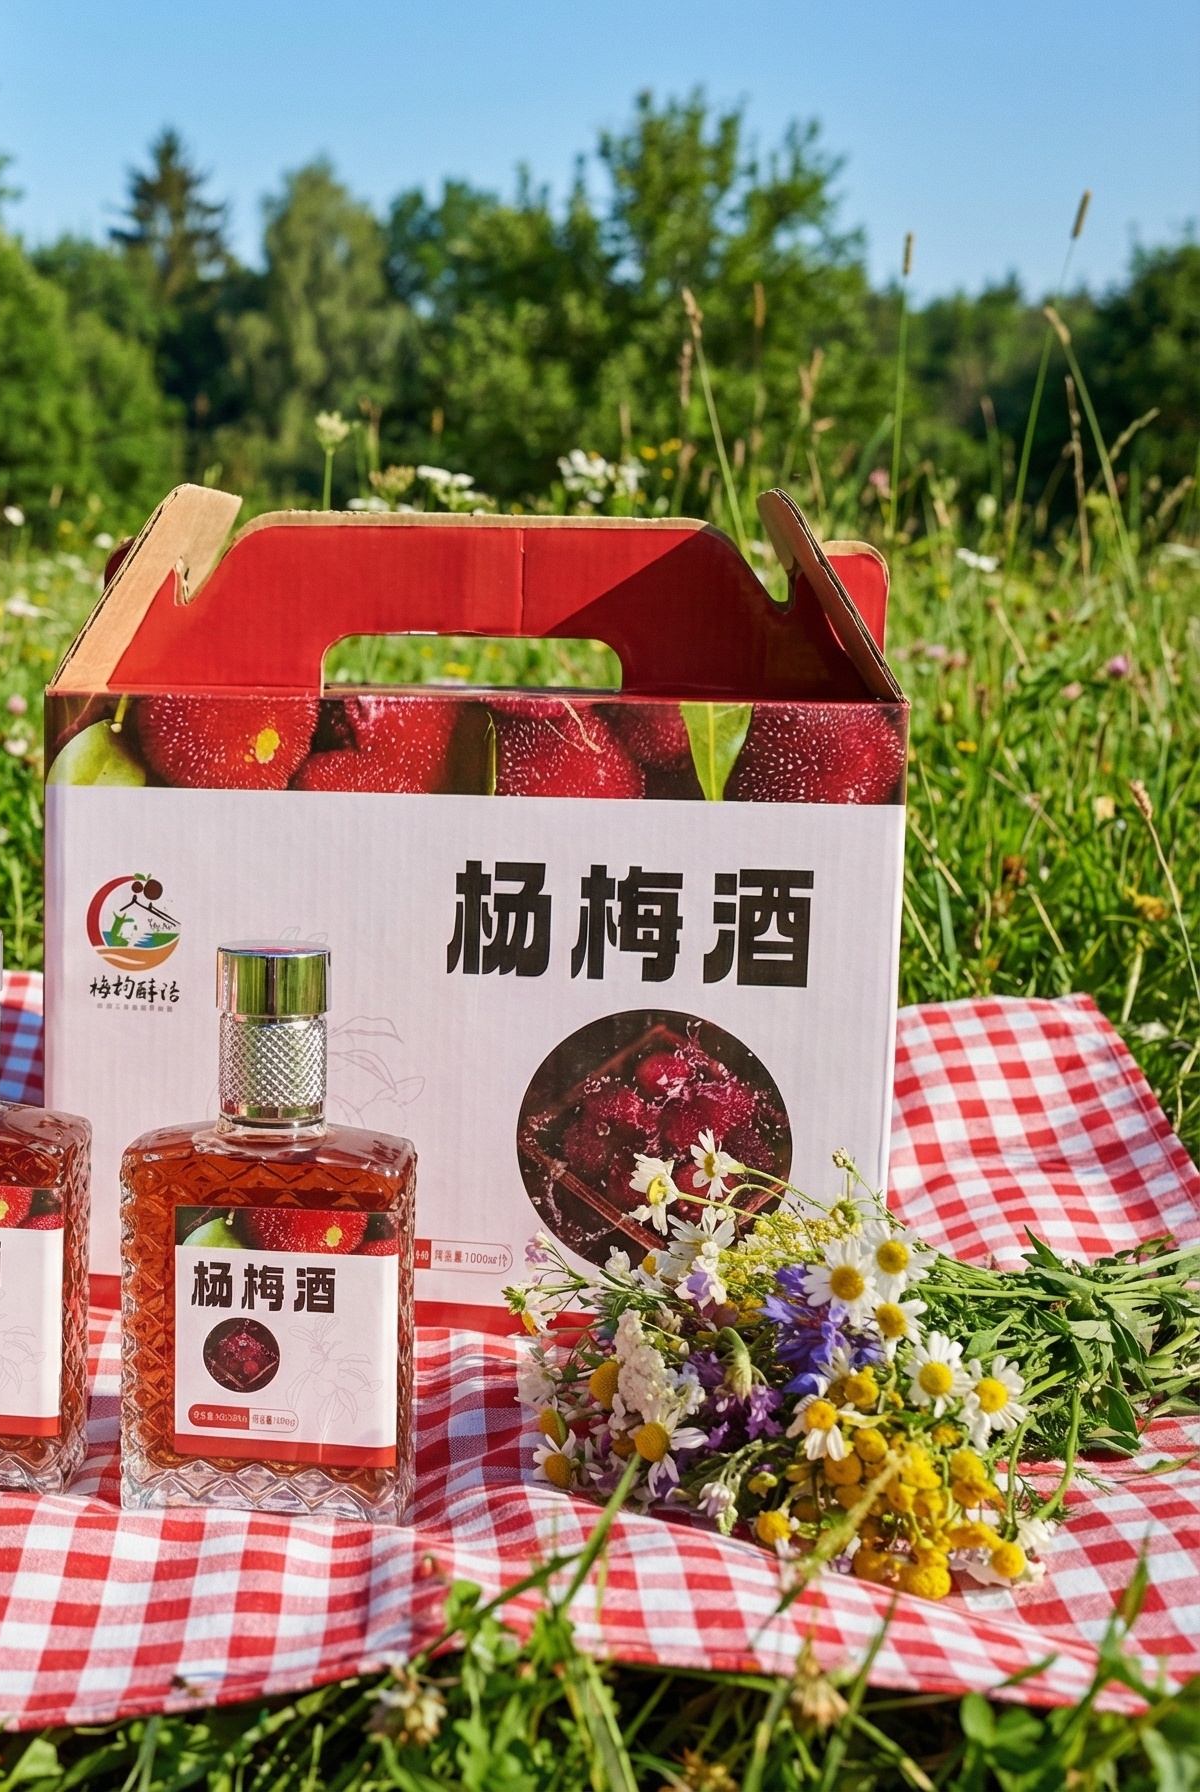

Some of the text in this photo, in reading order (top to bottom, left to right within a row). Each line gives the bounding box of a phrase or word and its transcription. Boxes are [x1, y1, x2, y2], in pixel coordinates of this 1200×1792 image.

[446, 859, 815, 988] 杨梅酒
[191, 1260, 337, 1314] 杨梅酒
